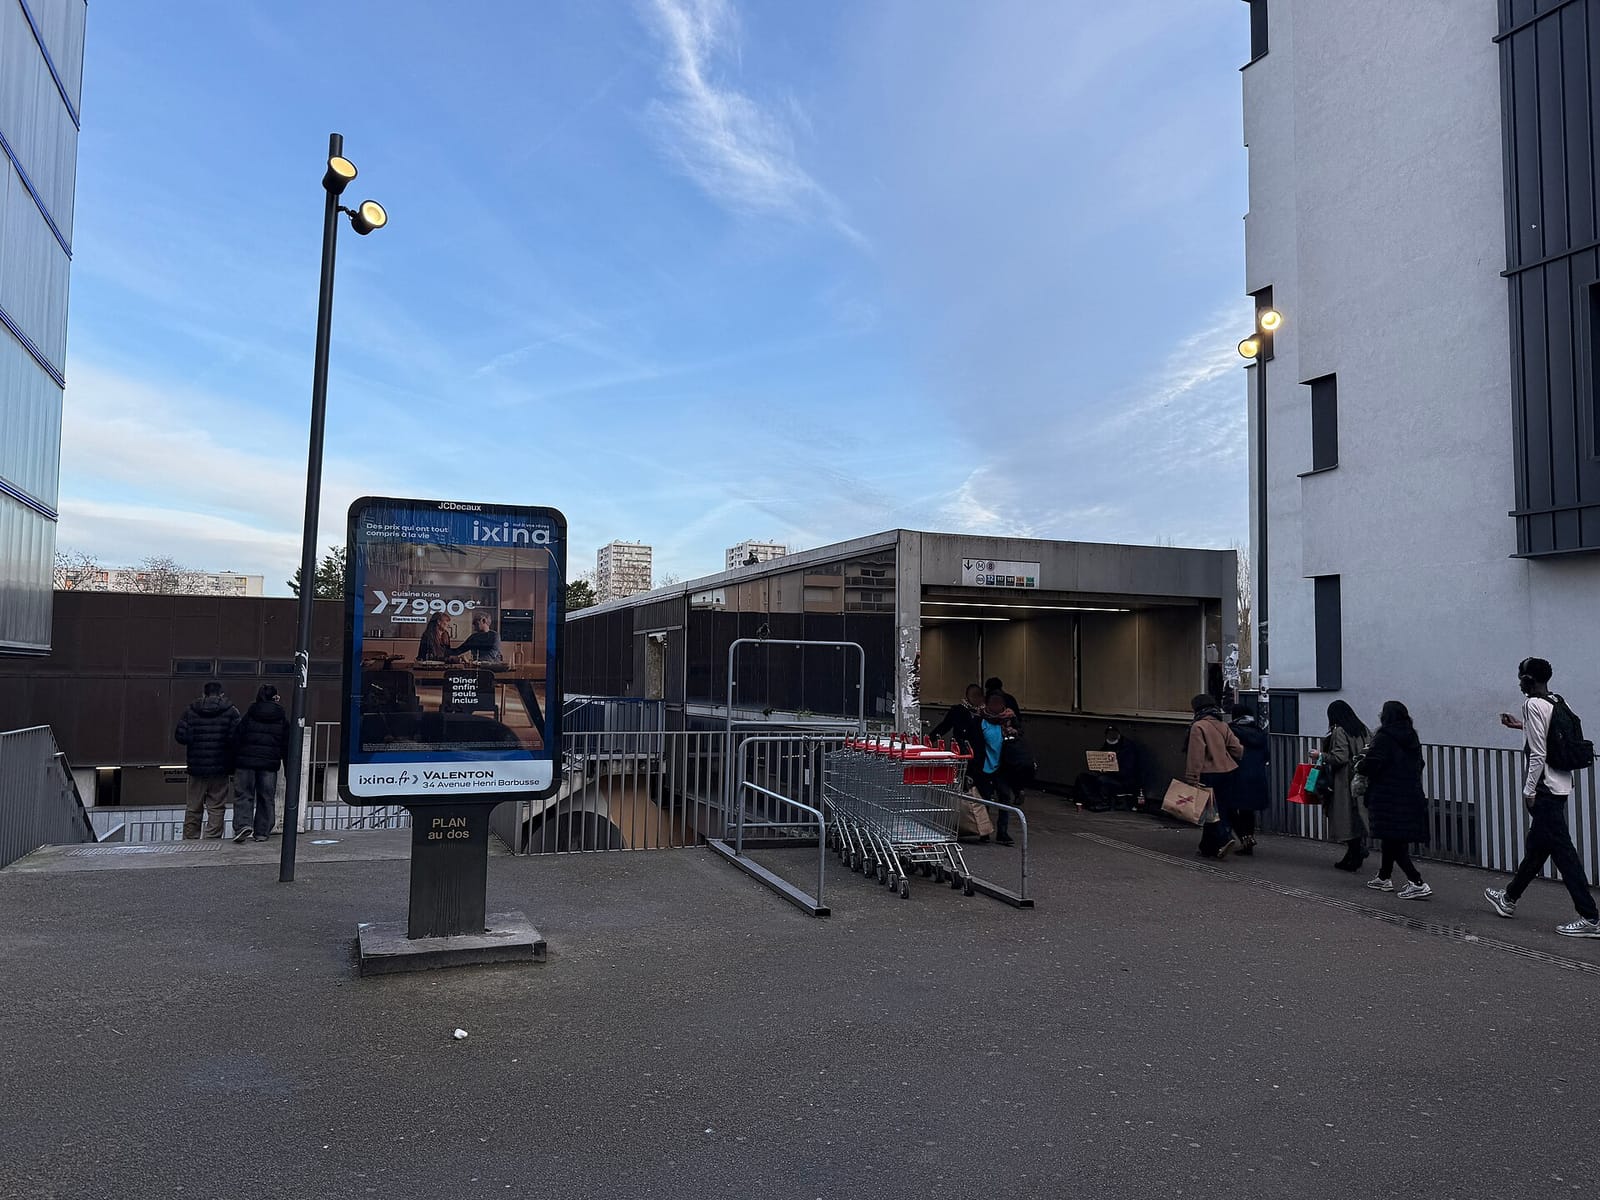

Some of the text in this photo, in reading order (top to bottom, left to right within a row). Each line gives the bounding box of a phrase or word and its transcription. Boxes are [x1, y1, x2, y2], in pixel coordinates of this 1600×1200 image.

[438, 502, 481, 511] JCDecaux
[384, 524, 400, 532] prix
[473, 520, 550, 545] ixina
[366, 530, 400, 538] compris
[391, 590, 420, 598] Cuisine
[359, 771, 410, 786] ixina.fr
[423, 771, 494, 780] VALENTON
[473, 779, 497, 787] Henri
[498, 779, 540, 787] Barbusse
[432, 817, 466, 828] PLAN
[428, 829, 470, 840] au dos
